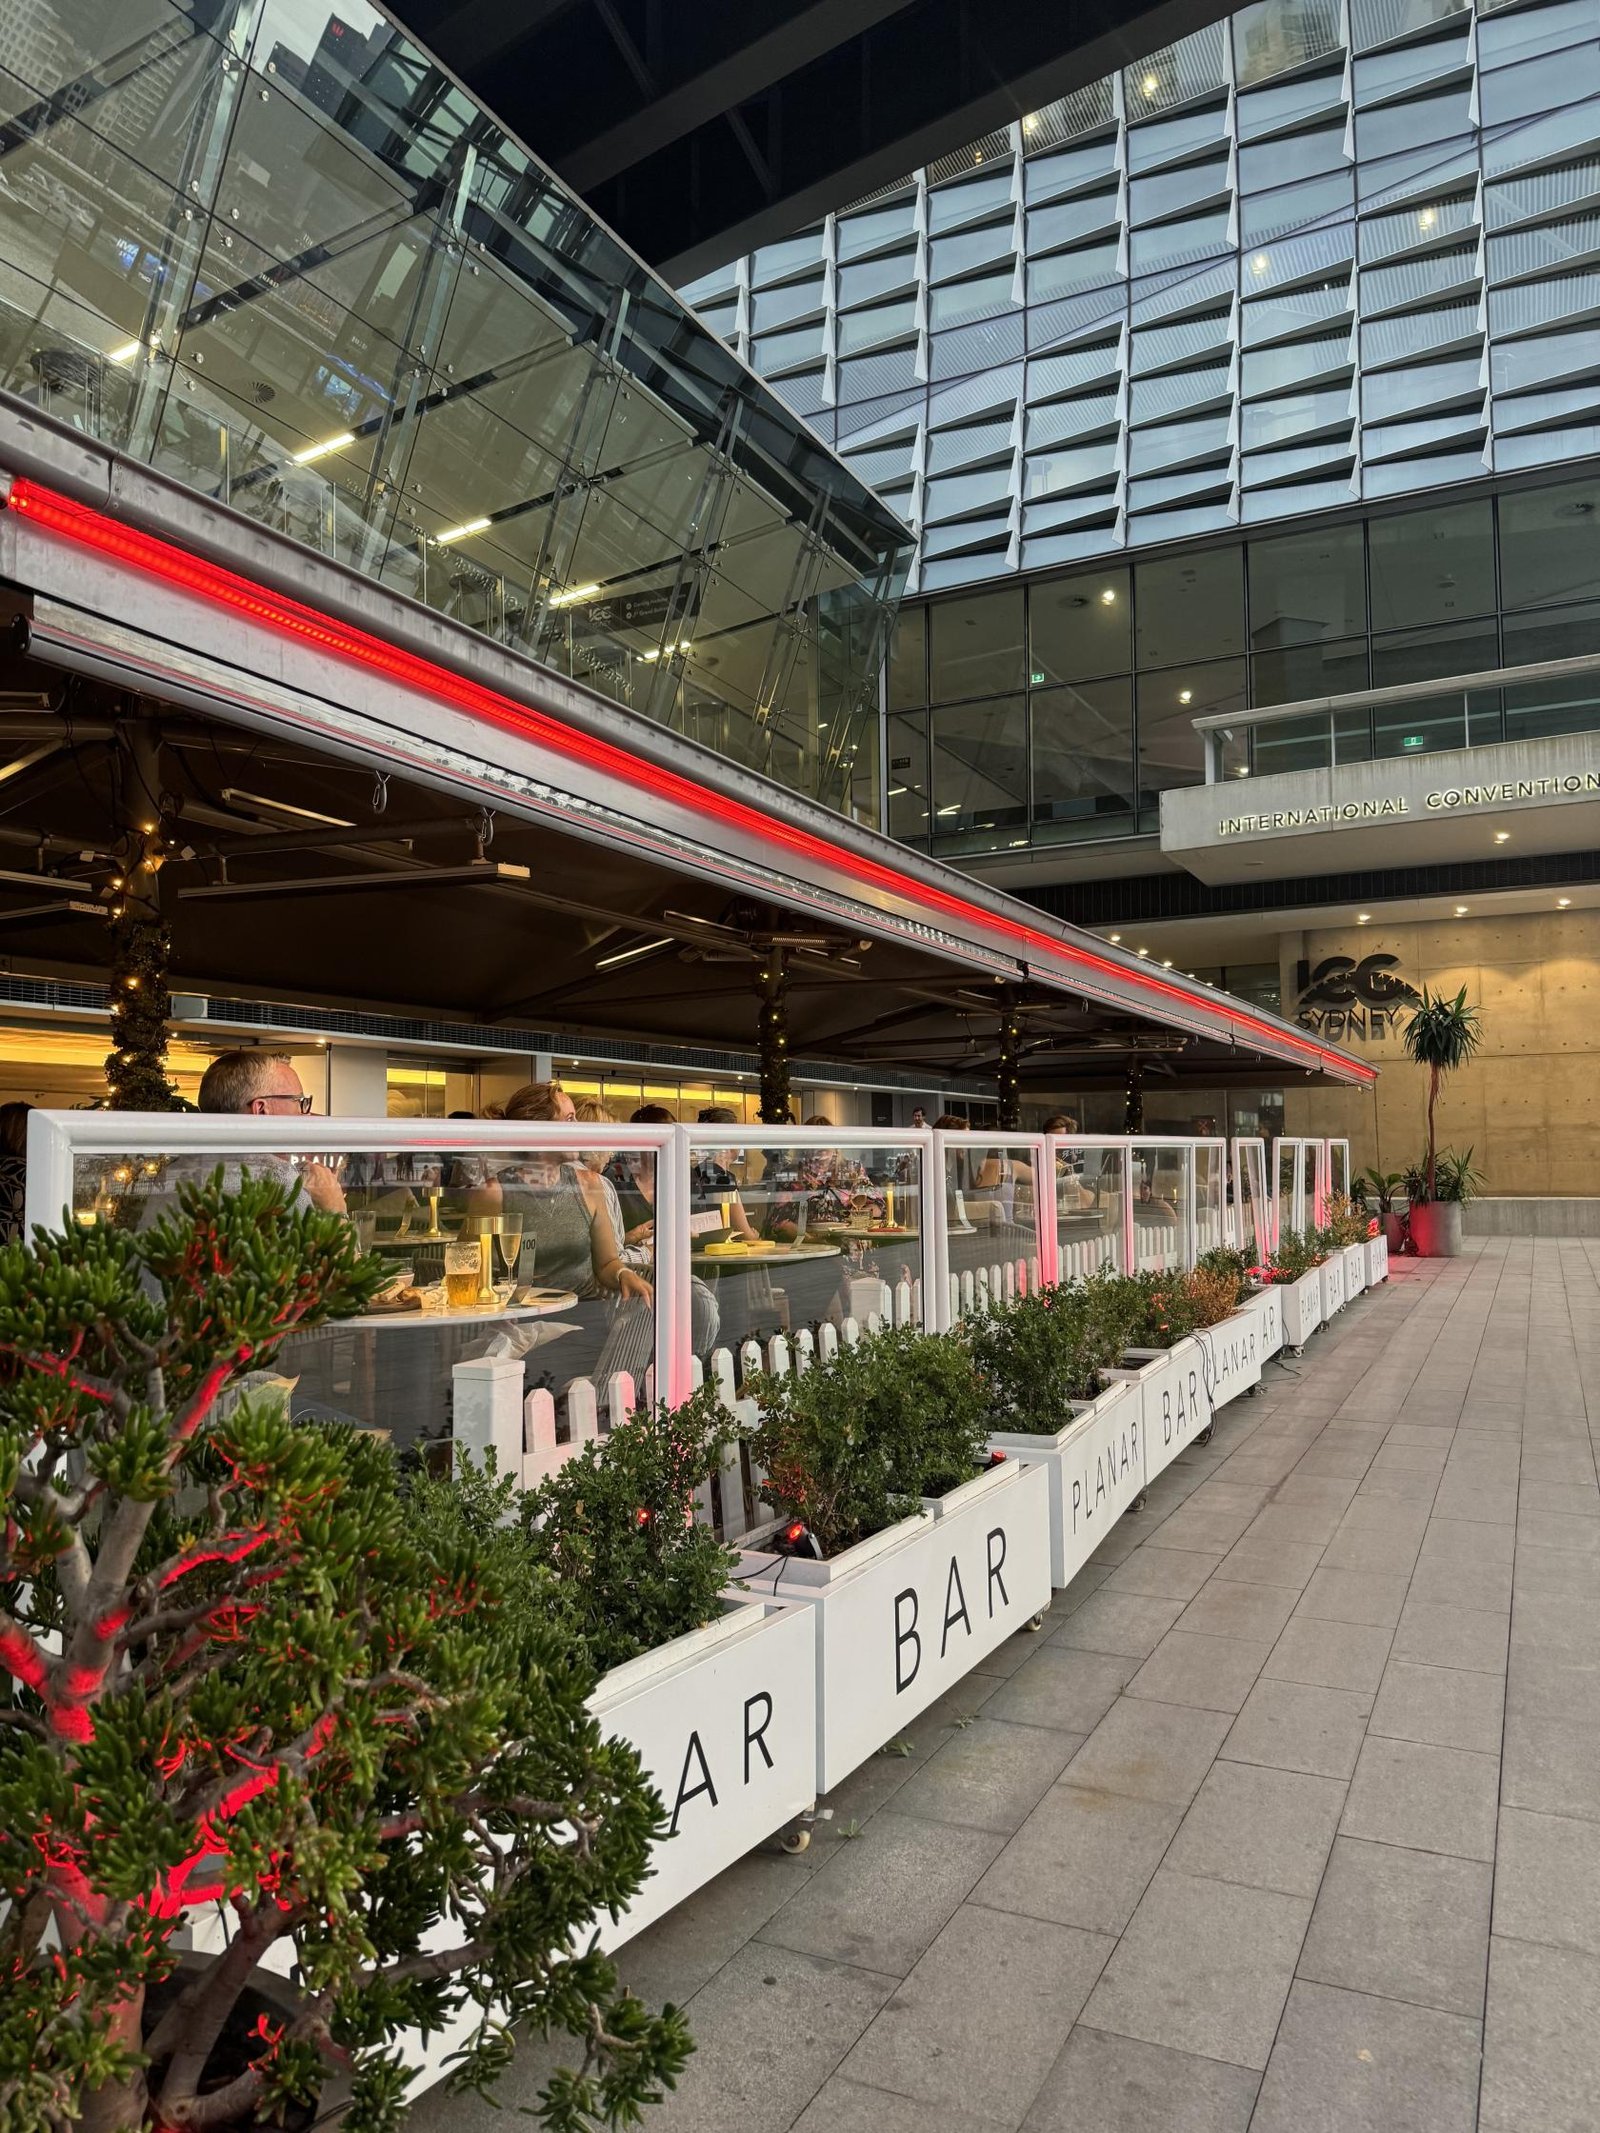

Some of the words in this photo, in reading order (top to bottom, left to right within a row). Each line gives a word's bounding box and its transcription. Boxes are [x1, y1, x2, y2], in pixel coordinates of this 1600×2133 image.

[1220, 797, 1409, 834] INTERNATIONAL
[1427, 772, 1600, 808] CONVENTION
[1297, 954, 1402, 1004] ICC
[1299, 1006, 1400, 1029] SYDNEY
[522, 1239, 536, 1250] 100
[1263, 1306, 1275, 1348] AR
[1162, 1370, 1198, 1446] BAR
[1072, 1421, 1138, 1535] PLANAR
[893, 1527, 1010, 1696] BAR
